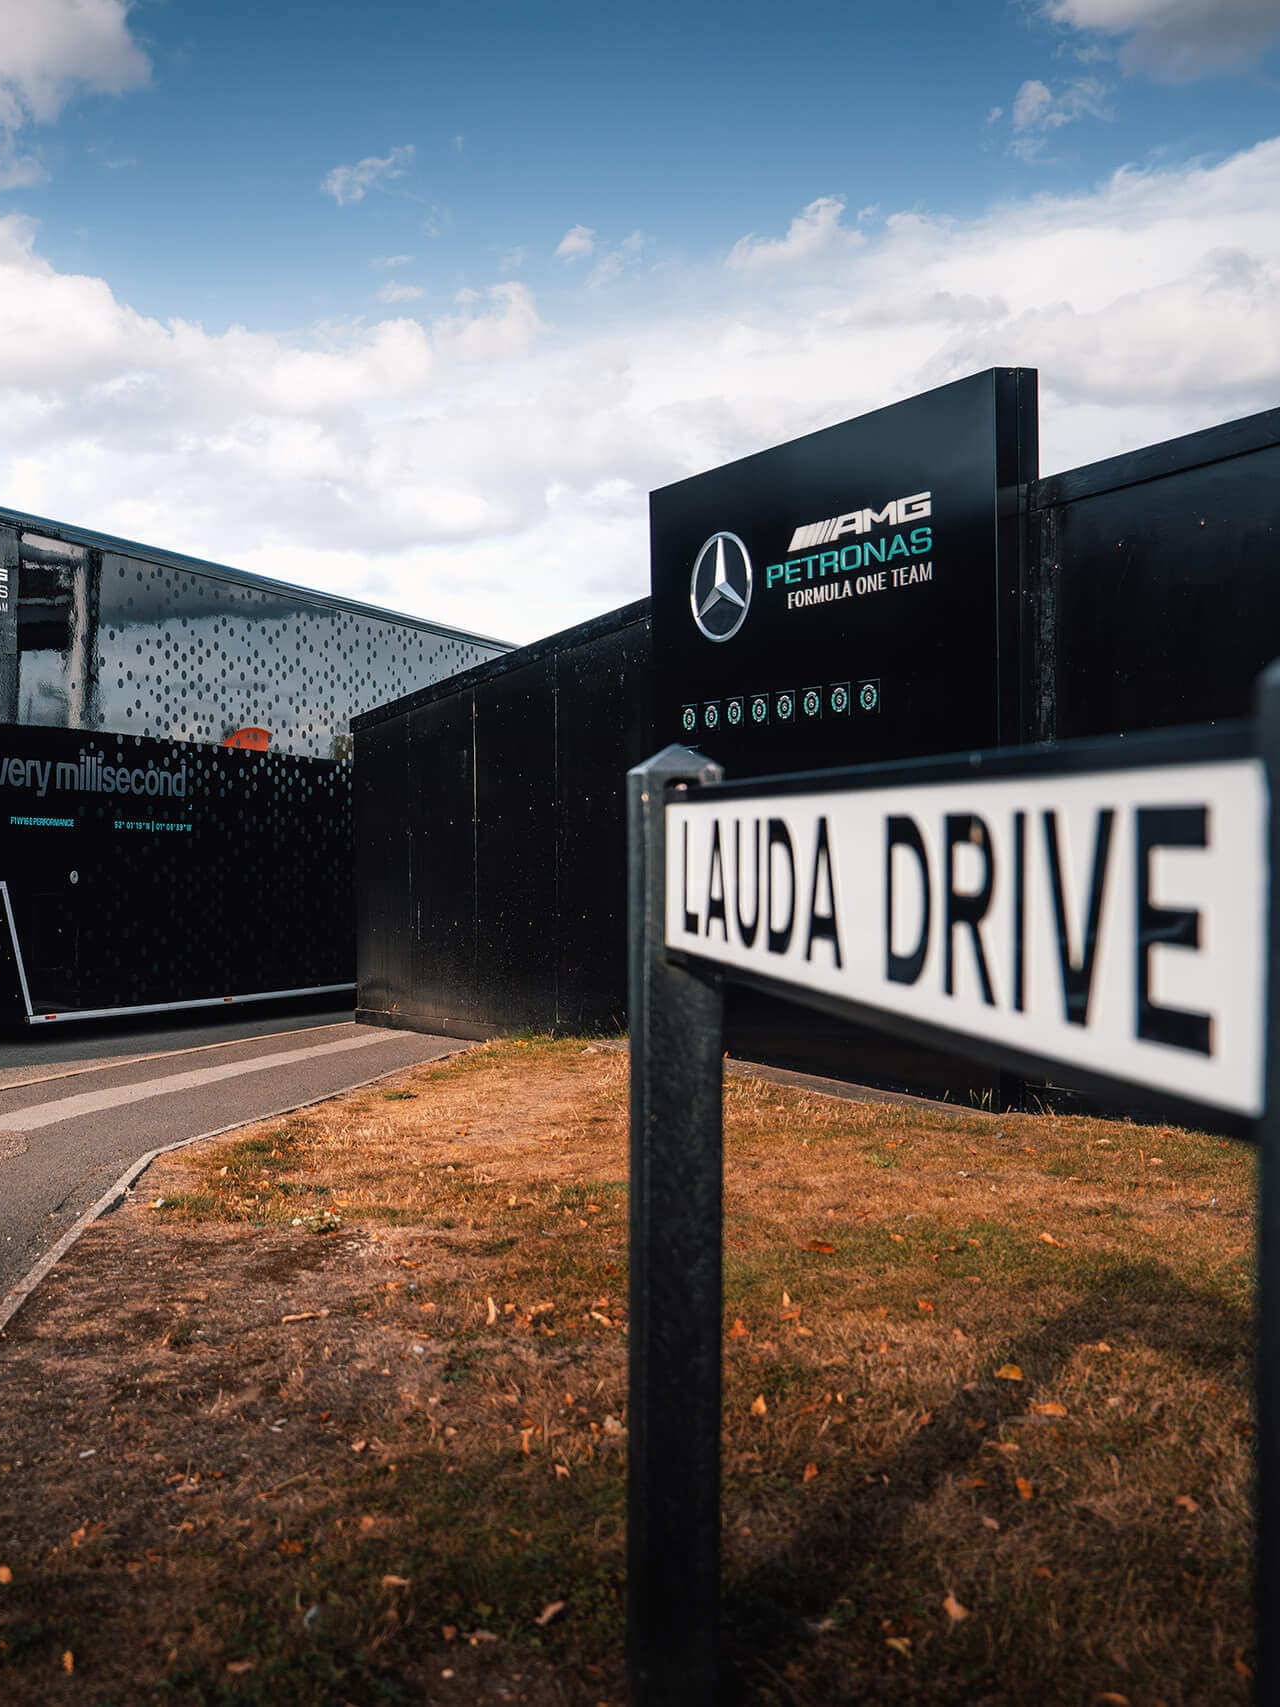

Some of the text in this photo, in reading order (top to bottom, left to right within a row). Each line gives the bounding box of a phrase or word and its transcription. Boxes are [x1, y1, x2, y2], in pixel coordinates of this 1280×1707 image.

[830, 491, 932, 541] AMG
[766, 527, 933, 589] PETRONAS
[787, 561, 933, 609] FORMULA ONE TEAM
[56, 749, 187, 797] millisecond
[33, 818, 74, 827] PERFORMANCE
[683, 802, 1216, 1059] LAUDA DRIVE
